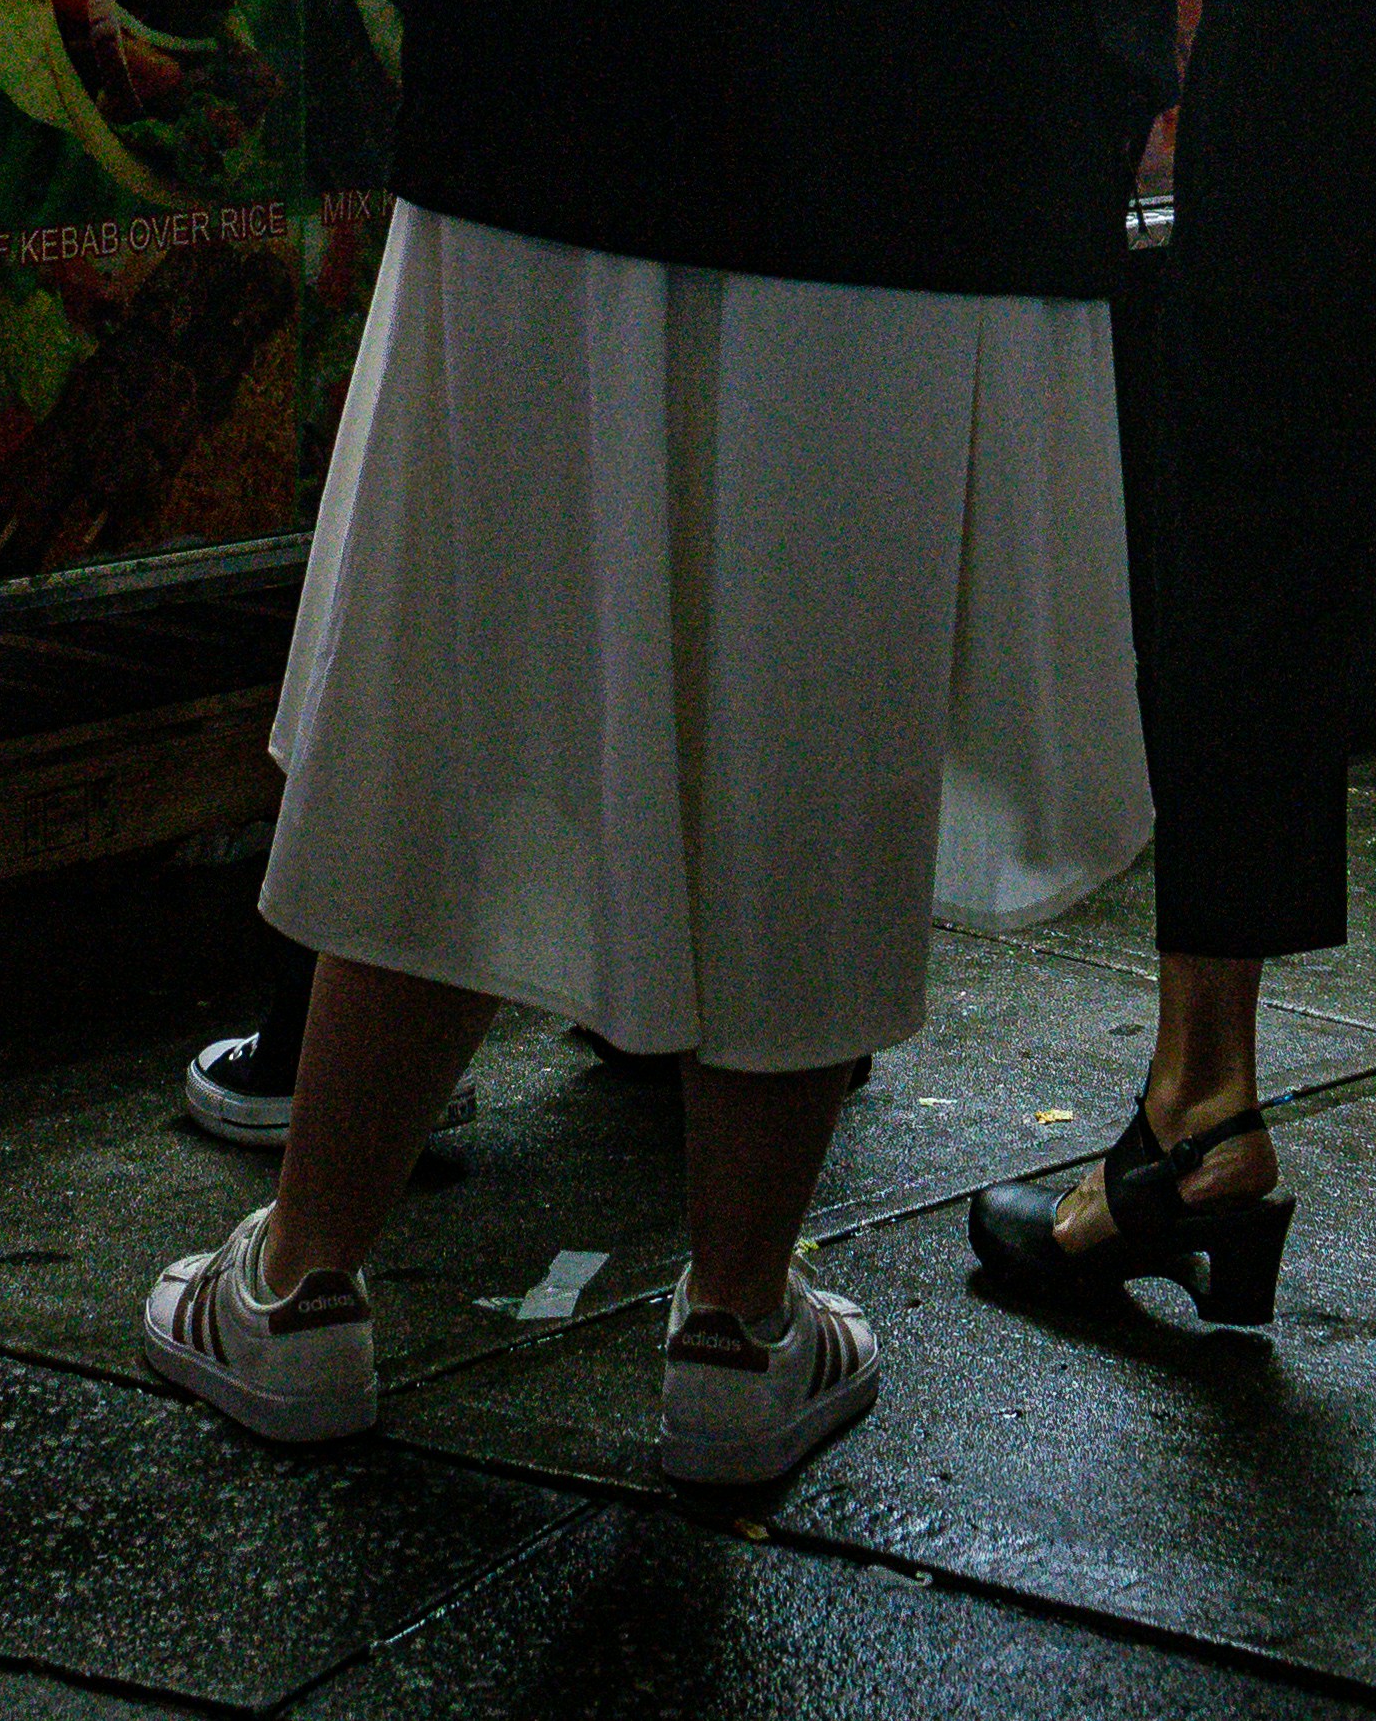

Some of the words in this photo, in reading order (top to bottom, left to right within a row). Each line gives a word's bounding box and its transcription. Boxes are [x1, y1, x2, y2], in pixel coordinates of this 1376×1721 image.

[21, 222, 118, 265] KEBAB
[128, 210, 212, 253] OVER
[220, 201, 286, 244] RICE
[321, 191, 375, 226] MIX
